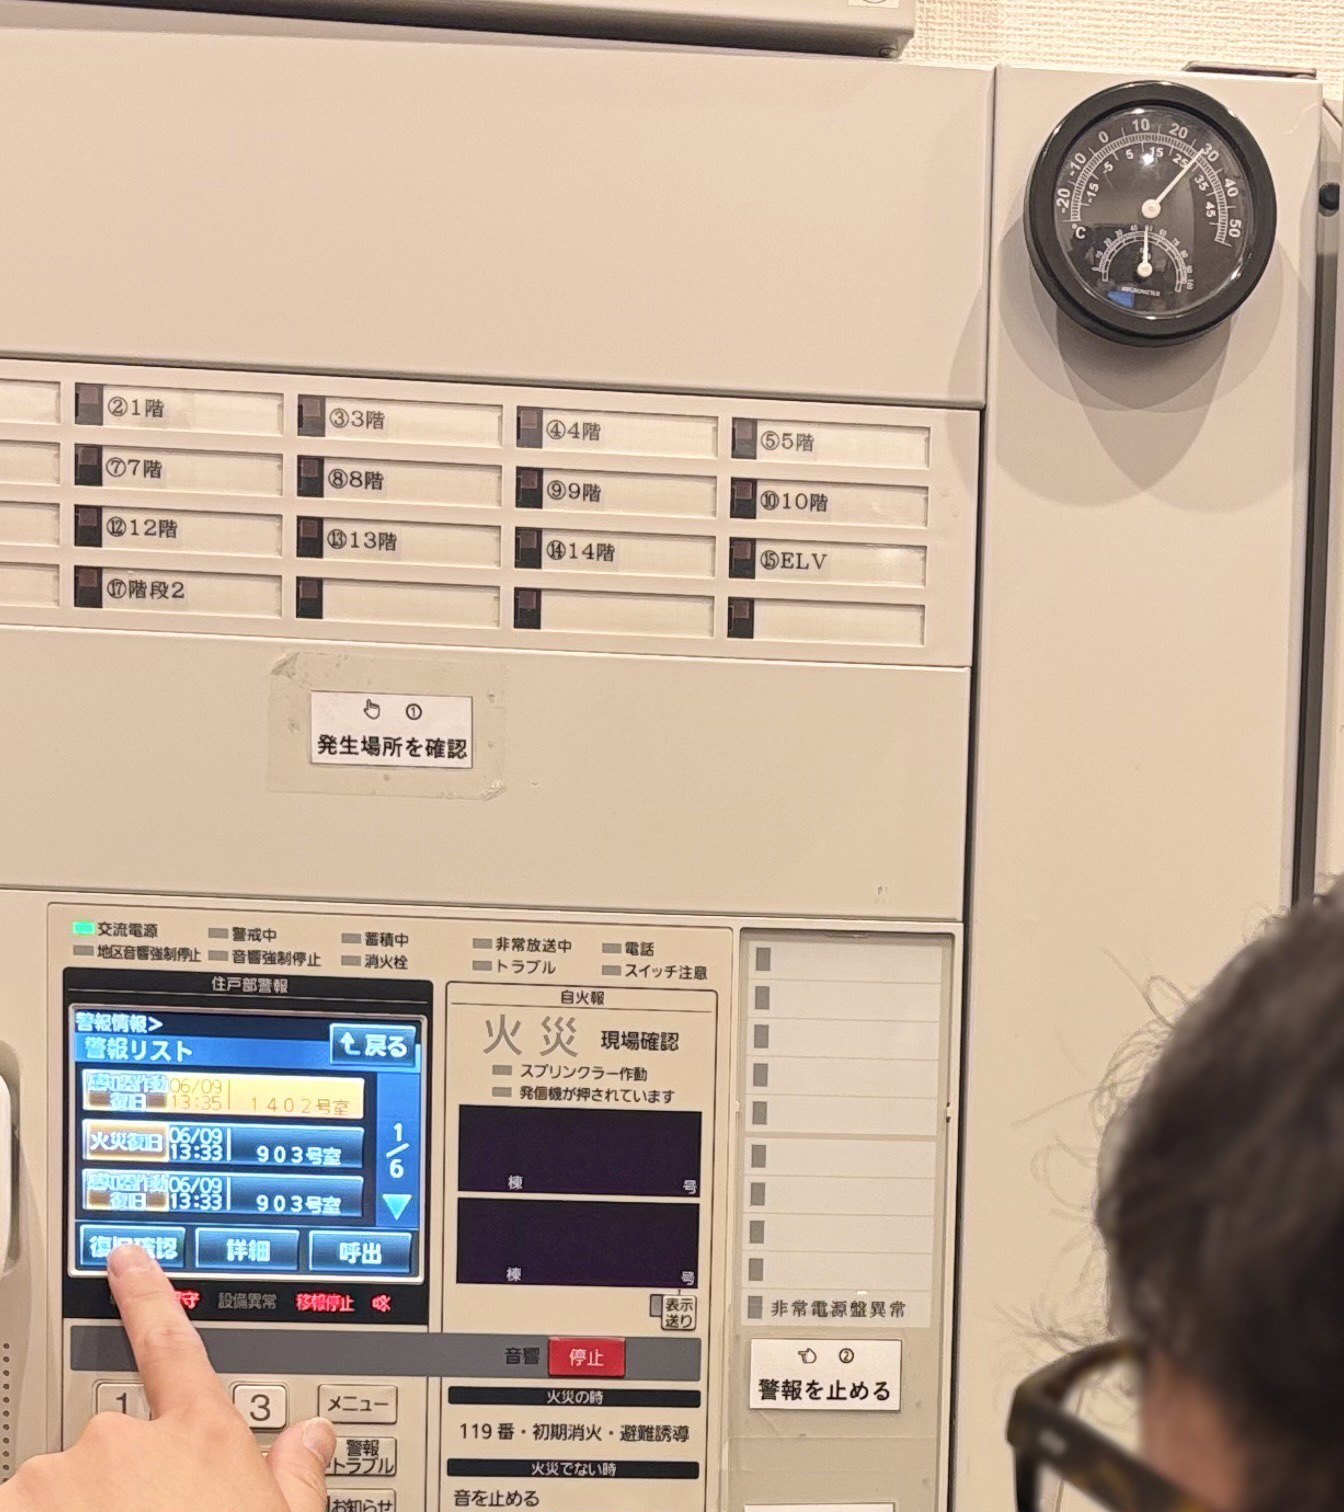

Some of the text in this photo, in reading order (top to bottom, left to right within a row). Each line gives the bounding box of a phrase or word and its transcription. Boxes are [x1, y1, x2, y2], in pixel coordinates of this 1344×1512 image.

[1132, 118, 1150, 131] 10
[1169, 123, 1188, 140] 20
[1098, 130, 1109, 143] 0
[1125, 148, 1134, 160] 5
[1172, 154, 1188, 169] 25
[1194, 174, 1207, 192] 35
[1224, 177, 1240, 198] 40
[1056, 187, 1071, 213] -20
[1205, 200, 1216, 218] 45
[1228, 218, 1242, 239] 50
[317, 734, 467, 759] 発生場所を確認
[97, 921, 158, 938] 交流電源
[232, 927, 277, 942] 警戒中
[365, 933, 409, 948] 蓄積中
[496, 937, 572, 954] 非常放送中
[625, 941, 654, 956] 電話
[97, 944, 201, 963] 地区音響強制停止
[232, 948, 322, 967] 音響強制停止
[365, 953, 409, 970] 消火栓
[497, 960, 556, 974] トラブル
[625, 964, 708, 981] スイッチ注意
[560, 990, 605, 1005] 自火報
[484, 1014, 578, 1057] 火災
[601, 1030, 680, 1052] 現場確認
[85, 1038, 193, 1063] 警報リスト
[365, 1033, 408, 1058] 戻る
[520, 1063, 648, 1082] スプリンクラー作動
[169, 1077, 222, 1094] 06/09
[171, 1094, 223, 1111] 13:35
[520, 1086, 676, 1104] 発信機が押されています
[90, 1131, 163, 1152] 火災復旧
[168, 1127, 223, 1144] 06/09
[170, 1144, 223, 1161] 13:33
[168, 1176, 223, 1194] 06/09
[508, 1174, 523, 1190] 棟
[683, 1179, 698, 1195] 号
[170, 1193, 223, 1210] 13:33
[227, 1239, 271, 1263] 詳細
[339, 1242, 382, 1266] 呼出
[506, 1266, 522, 1282] 棟
[681, 1271, 695, 1286] 号
[218, 1292, 277, 1311] 設備異常
[665, 1297, 694, 1313] 表示
[771, 1299, 906, 1319] 非常電源盤異常
[665, 1313, 693, 1329] 送り
[504, 1347, 540, 1365] 音響
[569, 1348, 604, 1367] 停止
[546, 1390, 603, 1405] 火災の時
[758, 1379, 890, 1401] 警報を止める
[115, 1392, 127, 1415] 1
[249, 1394, 271, 1422] 3
[328, 1395, 389, 1412] メニュー
[347, 1439, 379, 1457] 警報
[531, 1462, 616, 1477] 火災でない時
[453, 1489, 540, 1507] 音を止める
